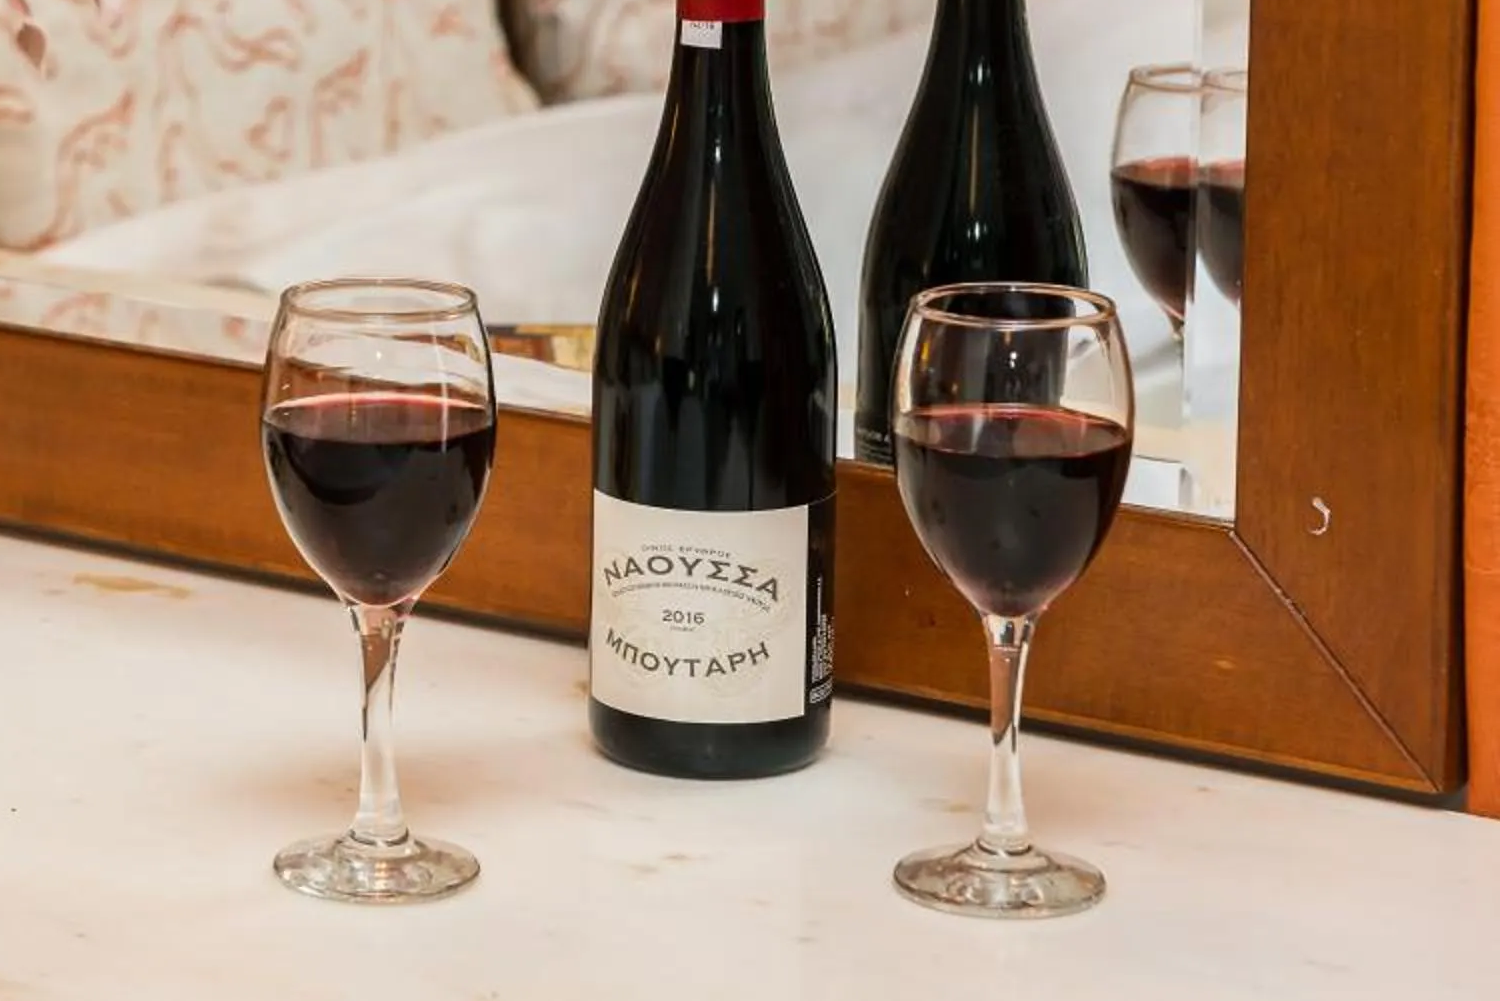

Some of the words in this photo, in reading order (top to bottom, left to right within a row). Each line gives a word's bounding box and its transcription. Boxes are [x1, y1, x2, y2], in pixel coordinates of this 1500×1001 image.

[603, 555, 779, 602] ΝΑΟΥΣΣΑ
[662, 609, 705, 626] 2016
[605, 627, 770, 678] ΜΠΟΥΤΑΡΗ
